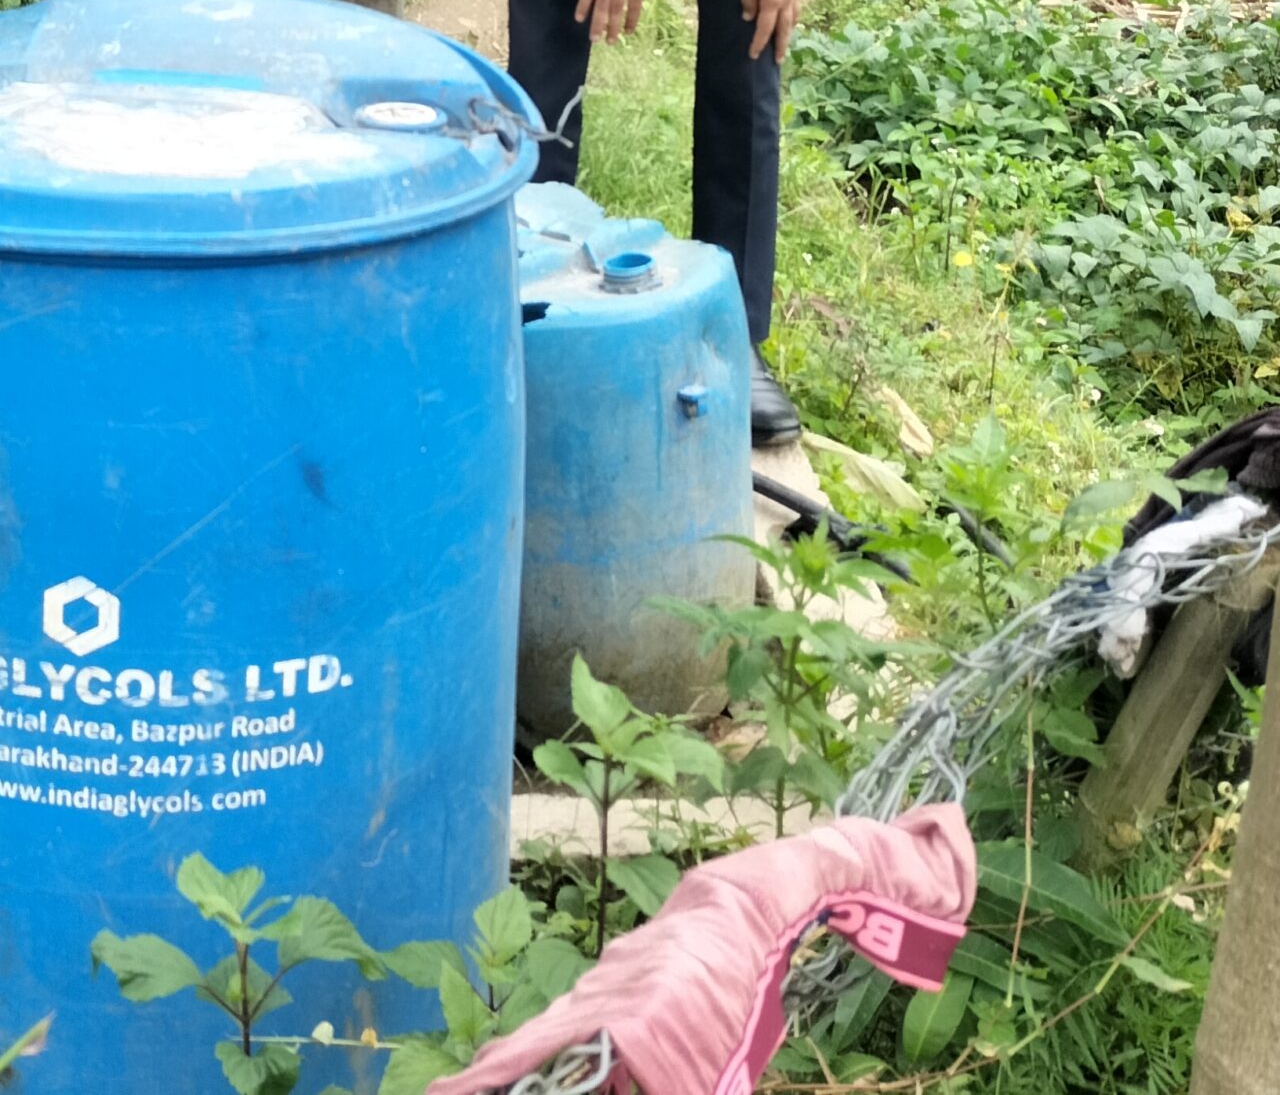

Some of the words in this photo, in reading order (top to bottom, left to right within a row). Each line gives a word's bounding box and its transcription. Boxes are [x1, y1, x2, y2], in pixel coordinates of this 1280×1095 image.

[245, 654, 354, 703] LTD.
[53, 713, 124, 745] Area,
[131, 719, 225, 747] Bazpur
[231, 707, 297, 738] Road
[232, 739, 325, 778] (INDIA)
